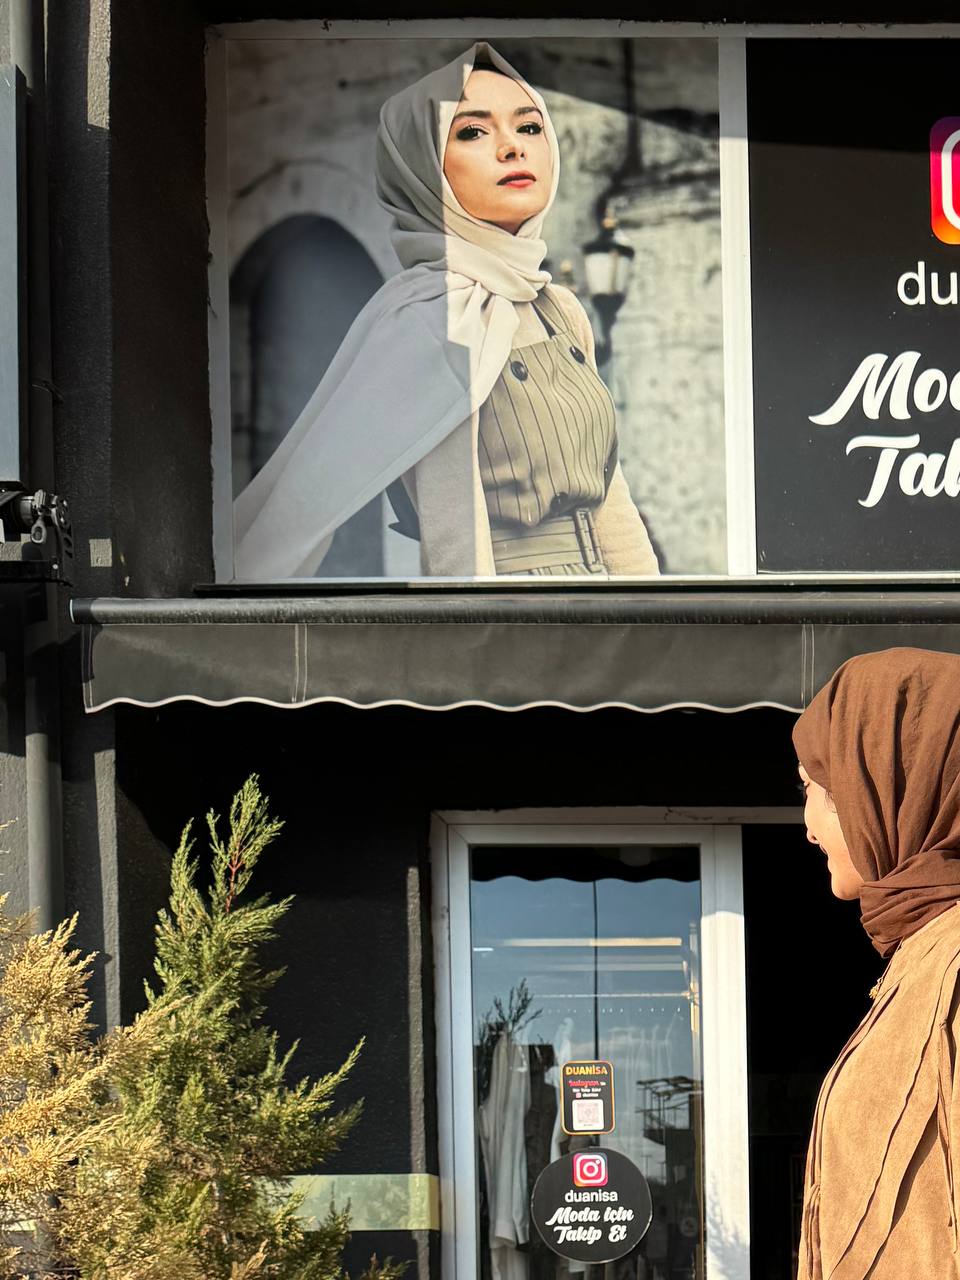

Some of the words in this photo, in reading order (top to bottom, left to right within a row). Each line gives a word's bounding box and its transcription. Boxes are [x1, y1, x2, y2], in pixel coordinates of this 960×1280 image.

[564, 1188, 619, 1203] duanisa
[545, 1206, 601, 1226] Moda
[603, 1206, 635, 1224] için
[553, 1225, 603, 1245] Takip
[608, 1224, 628, 1243] Et
